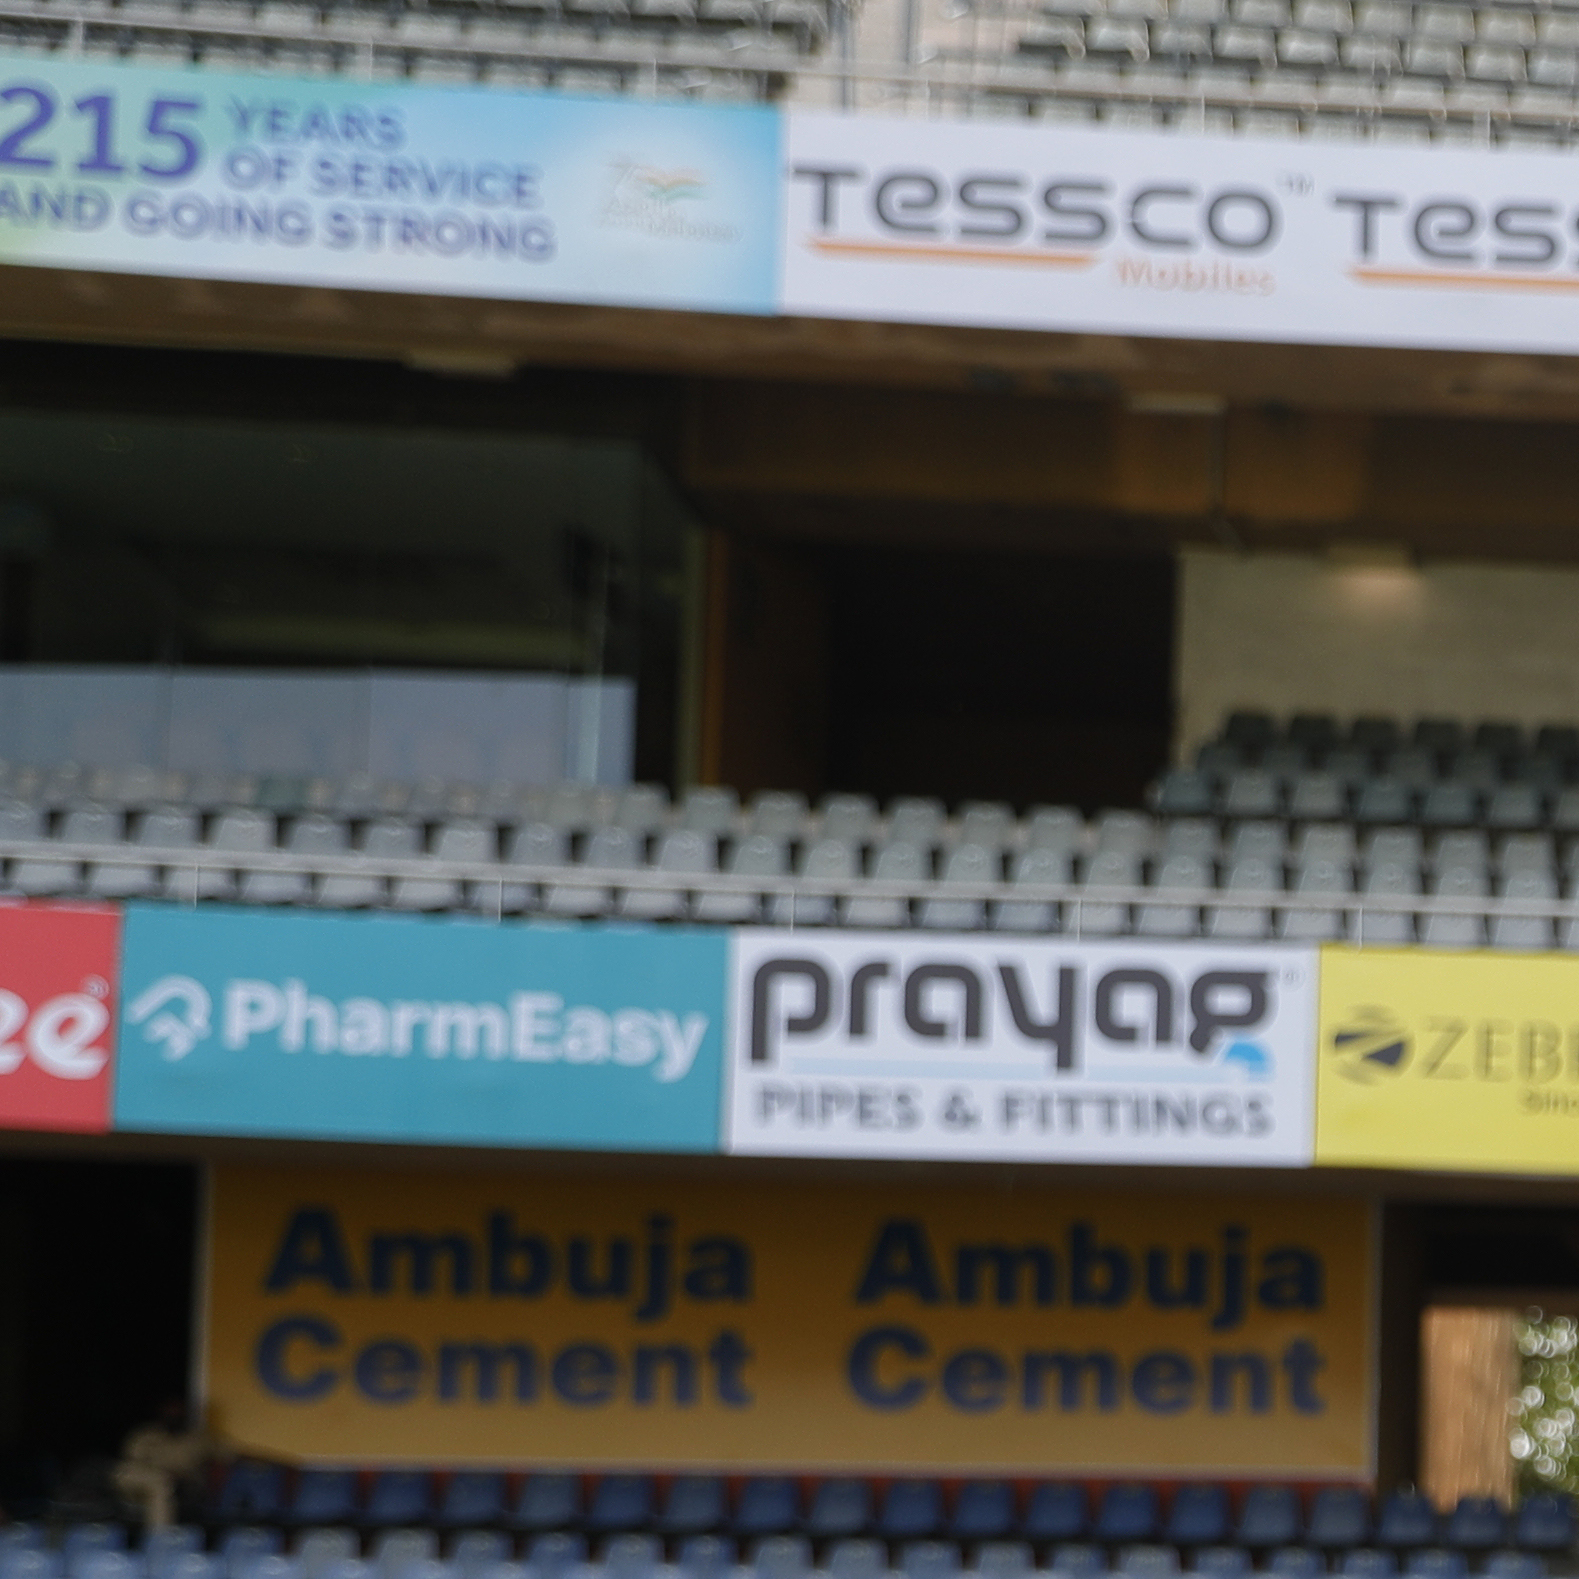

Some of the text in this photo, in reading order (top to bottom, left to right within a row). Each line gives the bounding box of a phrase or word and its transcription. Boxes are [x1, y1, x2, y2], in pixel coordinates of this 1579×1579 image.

[0, 86, 203, 181] 215
[229, 99, 410, 153] YEARS
[0, 179, 558, 264] AND GOING STRONG
[224, 146, 295, 192] OF
[312, 149, 547, 207] SERVICE
[220, 975, 710, 1085] PharmEasy
[750, 957, 1272, 1072] prayag
[757, 1088, 1278, 1140] PIPES & FITTINGS
[263, 1210, 755, 1323] Ambuja
[853, 1219, 1327, 1331] Ambuja
[253, 1314, 755, 1408] Cement
[845, 1324, 1327, 1417] Cement
